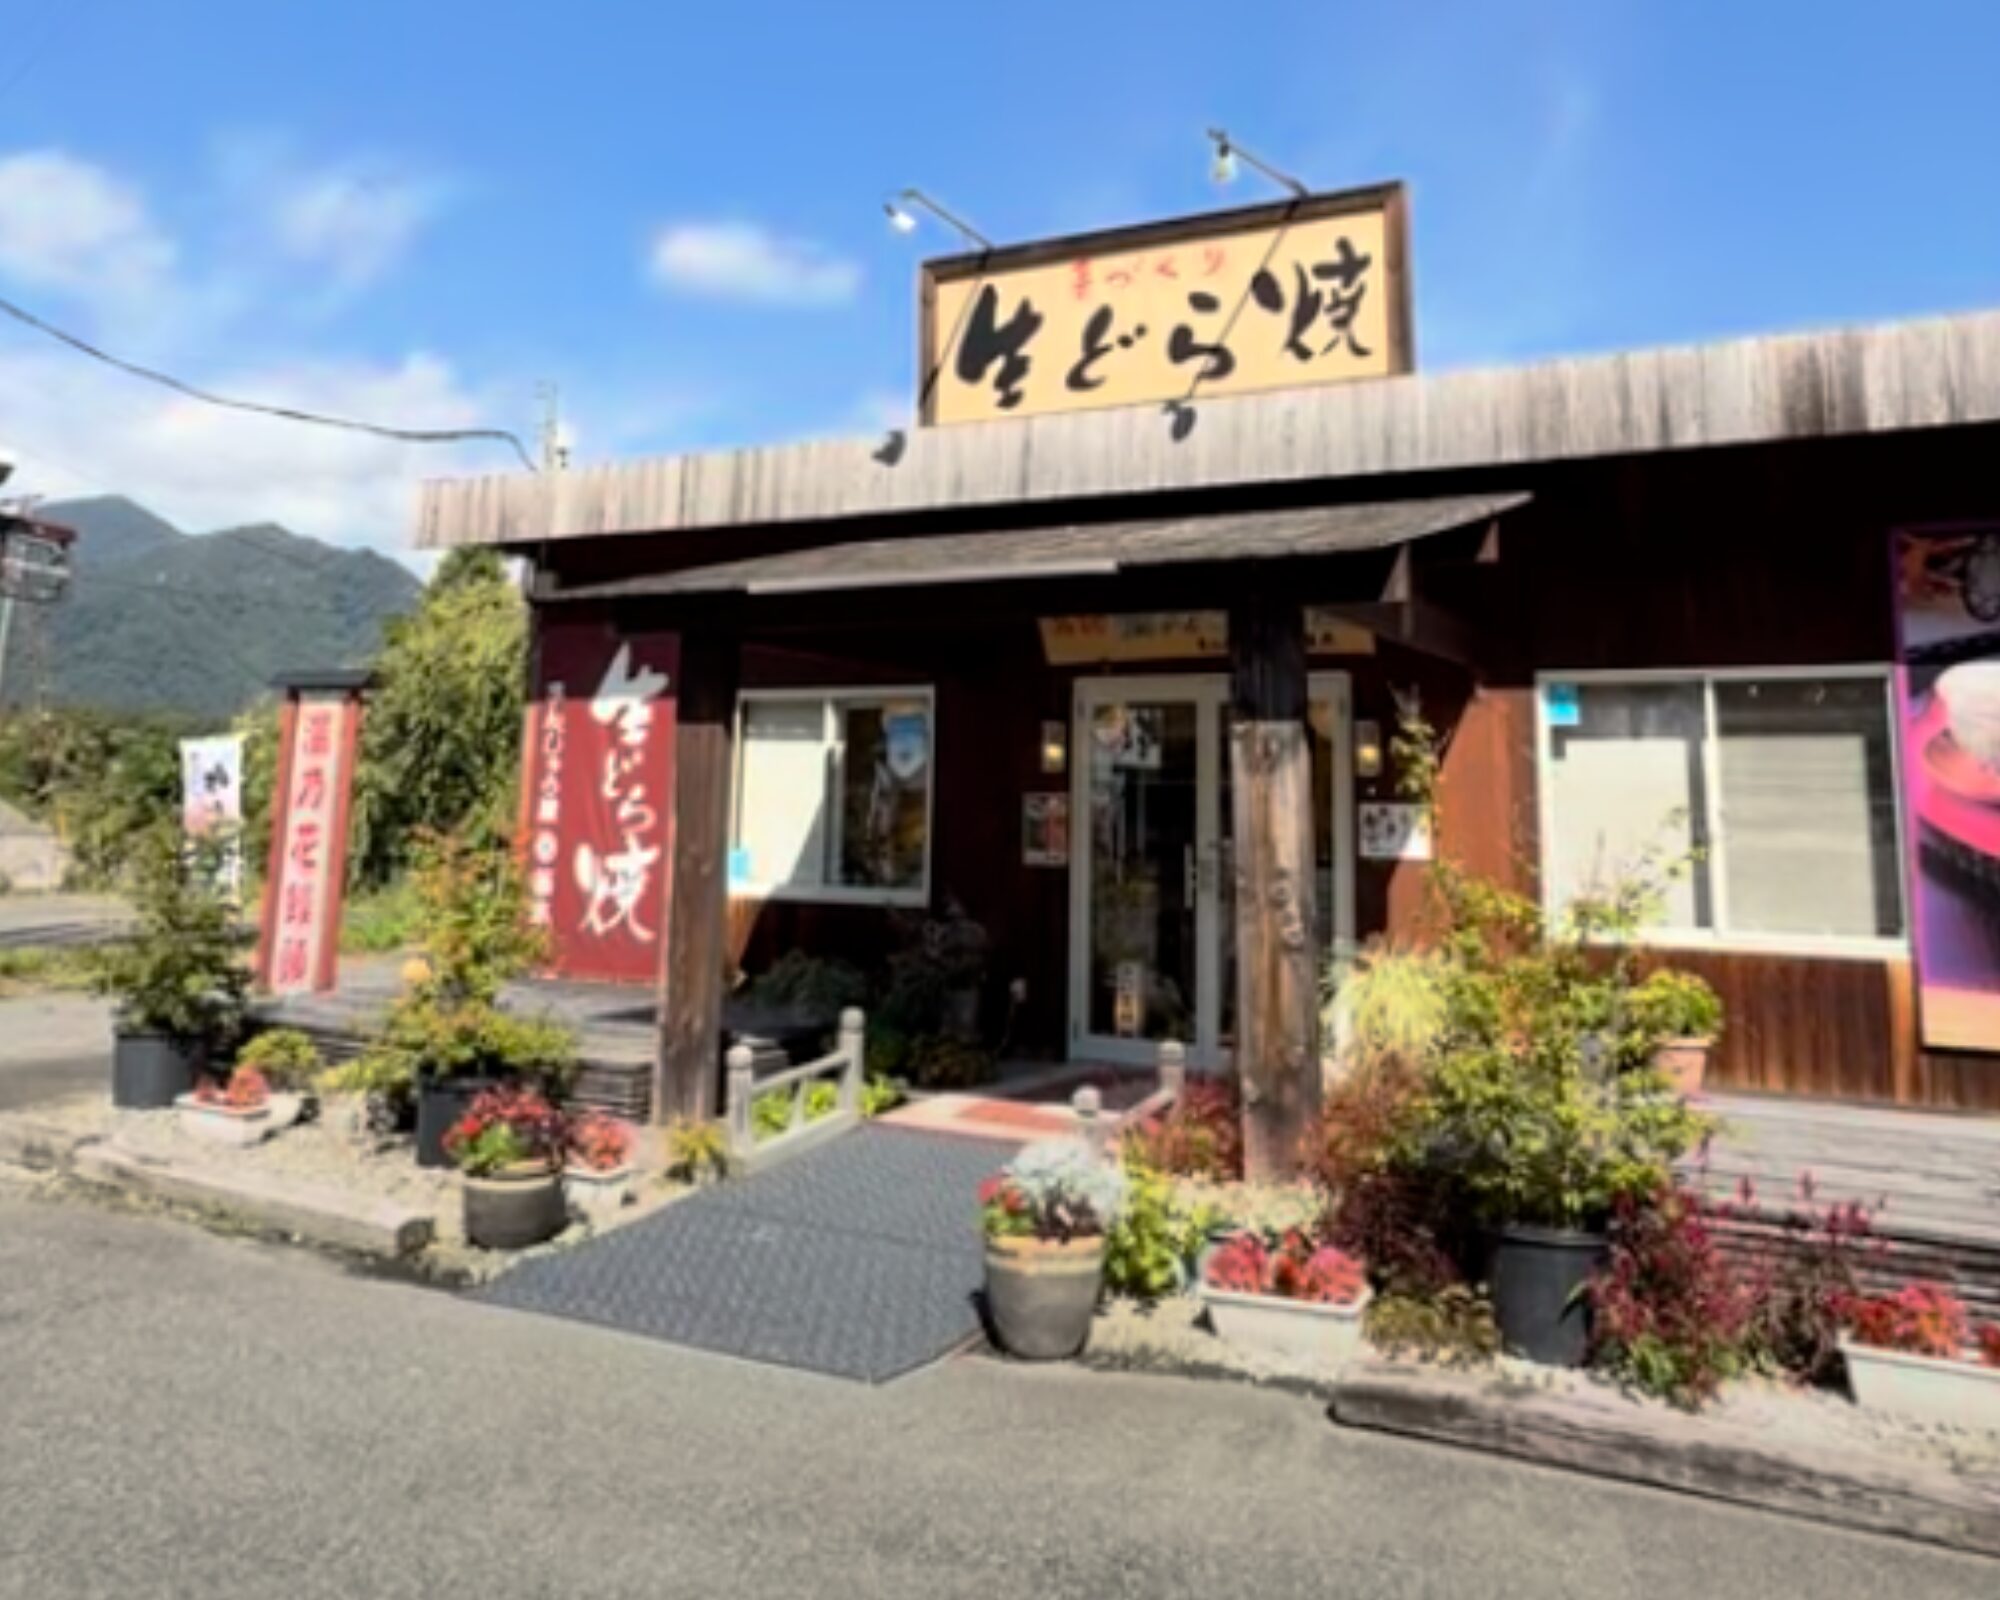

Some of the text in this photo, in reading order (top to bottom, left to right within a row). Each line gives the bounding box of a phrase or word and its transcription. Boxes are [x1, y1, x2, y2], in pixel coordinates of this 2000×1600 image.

[956, 236, 1372, 409] 生どら焼
[574, 641, 669, 941] 生どら焼
